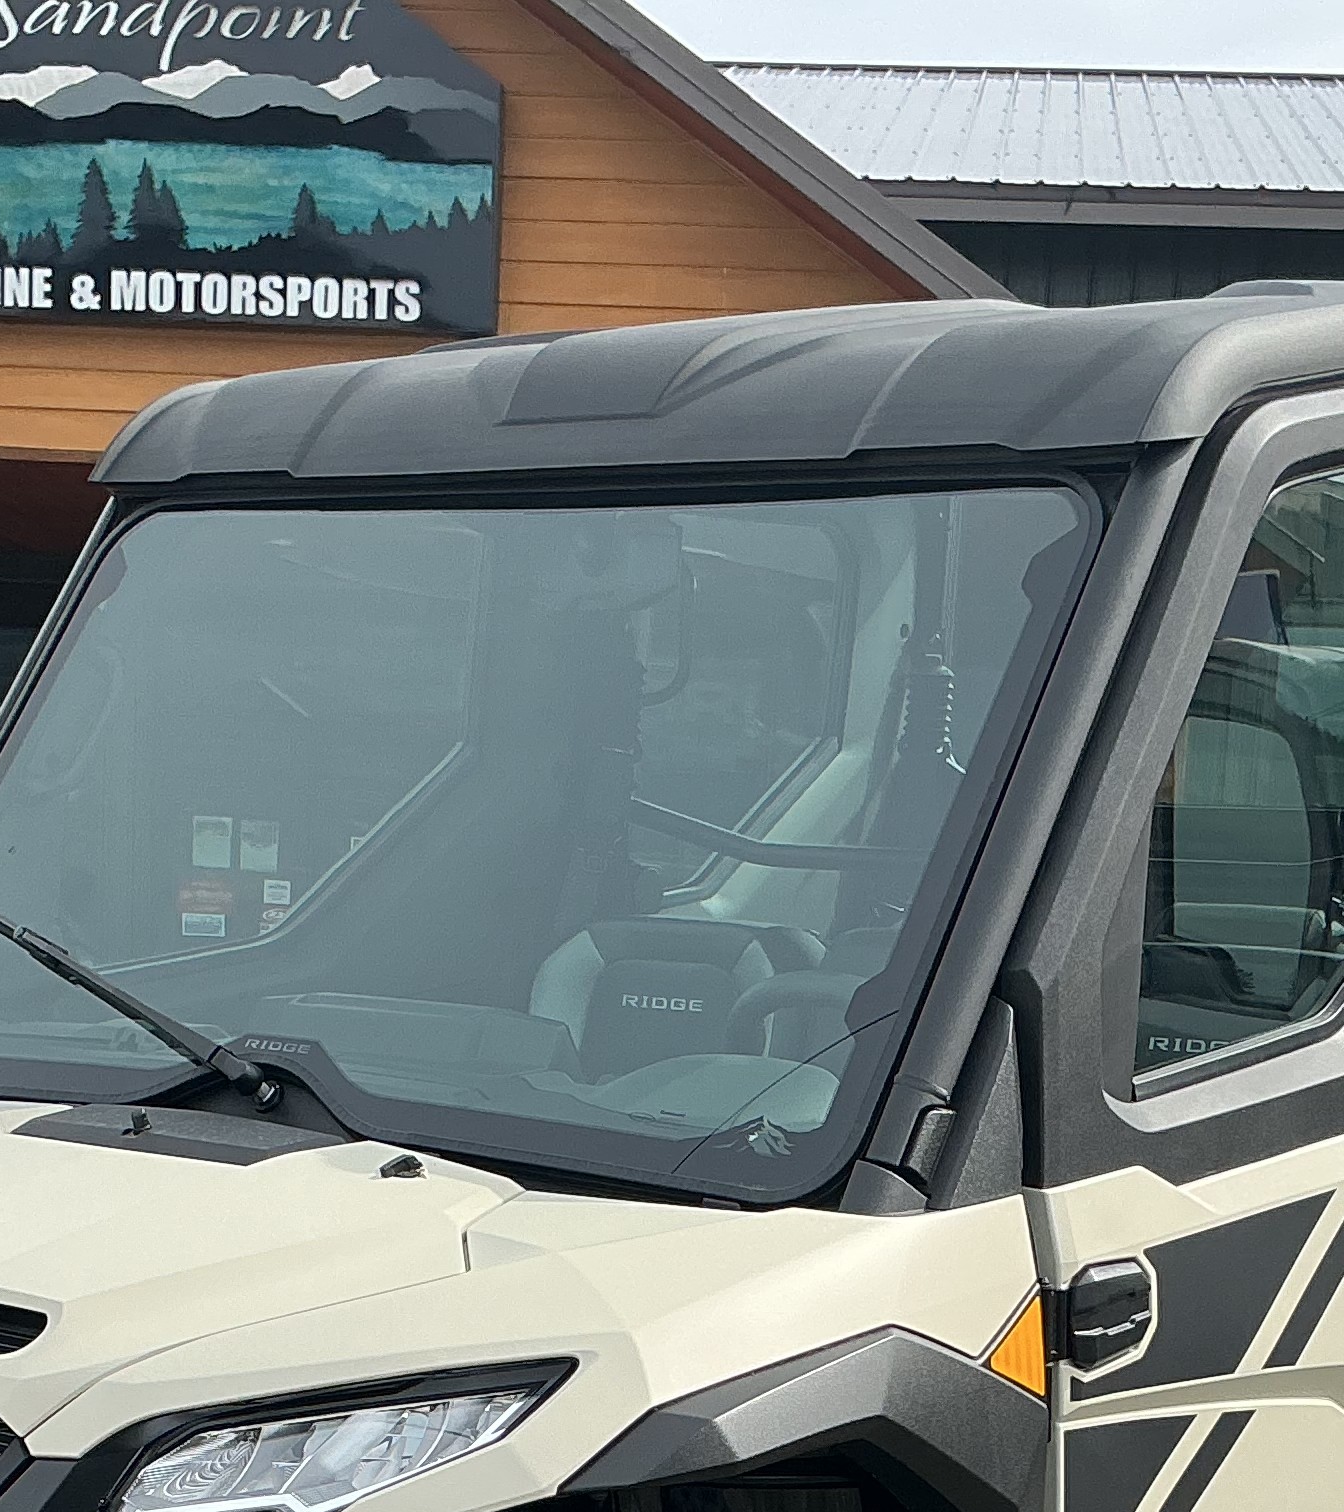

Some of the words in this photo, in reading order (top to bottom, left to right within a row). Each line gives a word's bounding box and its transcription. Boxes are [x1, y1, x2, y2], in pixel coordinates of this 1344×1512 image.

[69, 272, 102, 311] &
[109, 269, 423, 322] MOTORSPORTS
[621, 993, 704, 1012] RIDGE
[244, 1038, 311, 1055] RIDGE
[1148, 1036, 1231, 1053] RID
